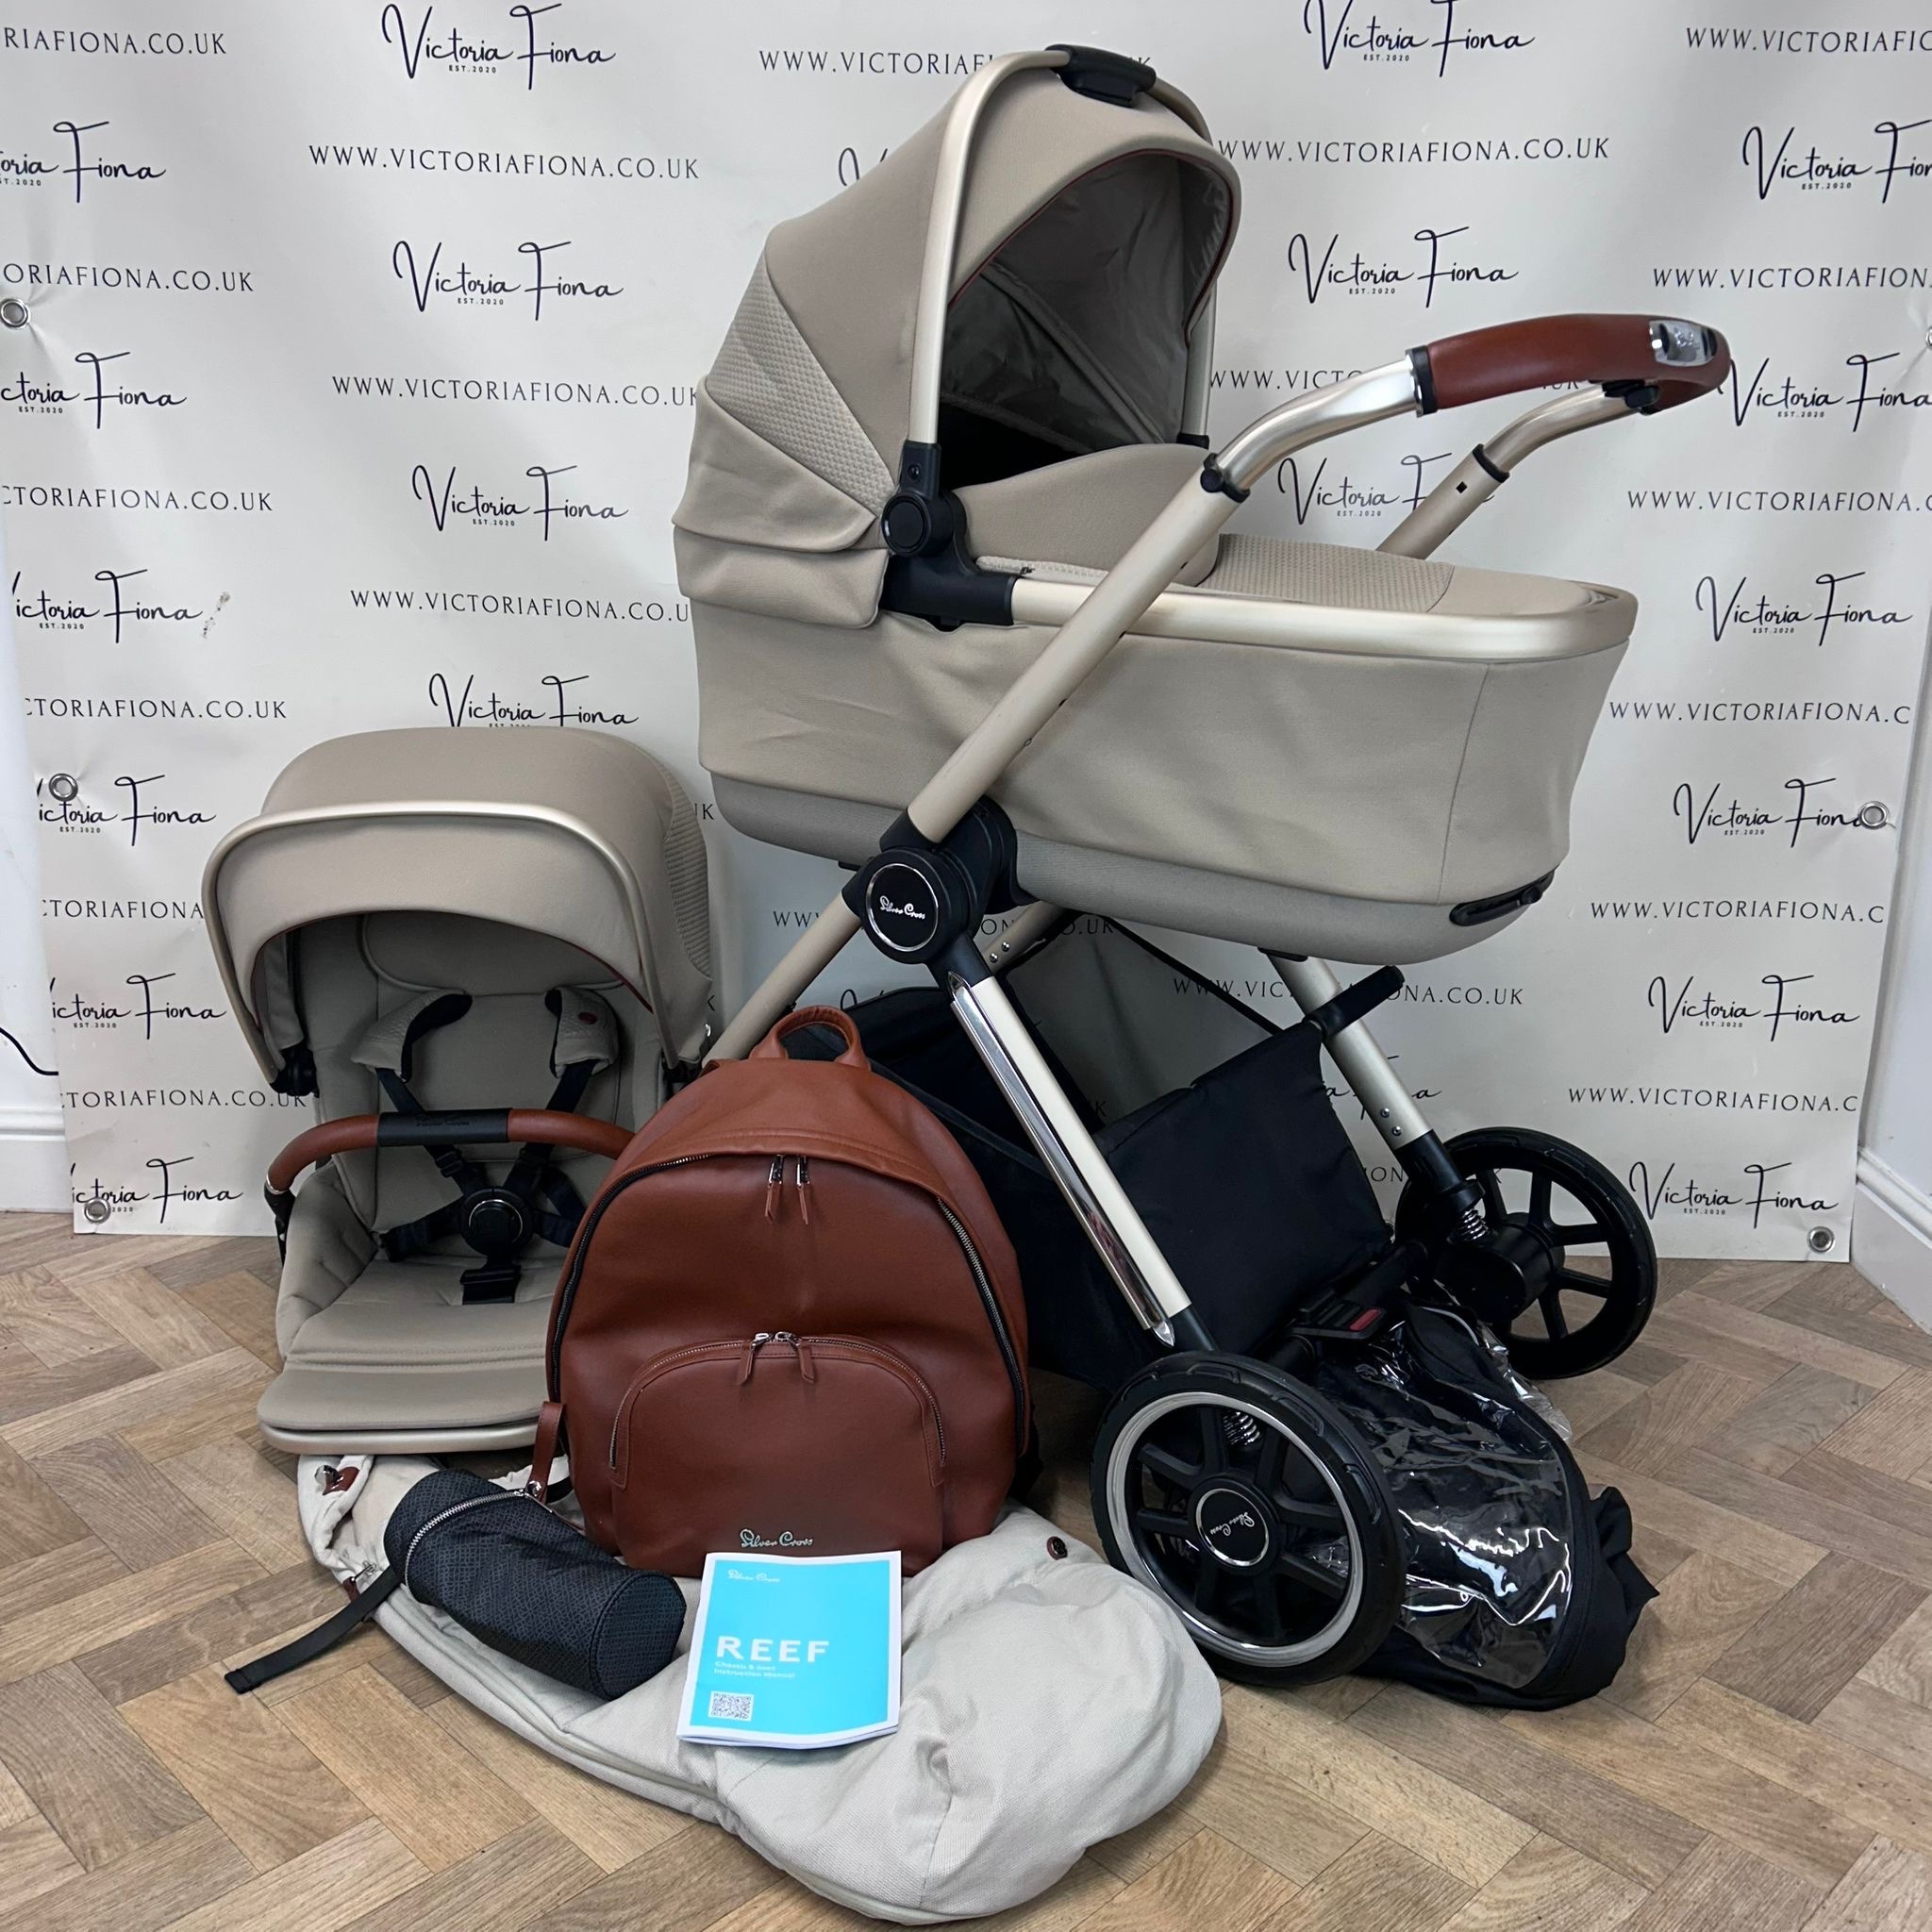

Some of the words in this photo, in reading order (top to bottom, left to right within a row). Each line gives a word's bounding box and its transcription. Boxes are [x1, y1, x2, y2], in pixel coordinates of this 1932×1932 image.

[381, 3, 514, 79] Victoria
[509, 3, 616, 91] Fiona
[449, 64, 496, 74] EST.2020
[1304, 0, 1429, 70] Victoria
[1431, 0, 1535, 77] Fiona
[0, 151, 58, 175] oria
[53, 121, 166, 204] Fiona
[309, 145, 699, 178] WWW.VICTORIAFIONA.CO.UK
[1219, 138, 1609, 162] WWW.VICTORIAFIONA.CO.UK
[1742, 126, 1873, 200] Victoria
[3, 263, 254, 291] ORIAFIONA.CO.UK
[392, 241, 521, 312] Victoria
[517, 242, 624, 321] Fiona
[1288, 234, 1415, 304] Victoria
[1414, 226, 1519, 308] Fiona
[1654, 267, 1932, 289] WWW.VICTORIAFION
[458, 297, 504, 306] EST.2020
[18, 406, 63, 414] EST.2020
[74, 352, 187, 429] Fiona
[412, 465, 531, 532] Victoria
[525, 465, 628, 541] Fiona
[473, 518, 515, 526] EST.2020
[1276, 455, 1400, 525] Victoria
[92, 569, 203, 643] Fiona
[1695, 576, 1813, 641] Victoria
[1814, 572, 1913, 646] Fiona
[428, 673, 546, 727] Victoria
[541, 675, 639, 727] Fiona
[1609, 702, 1910, 724] WWW.VICTORIAFIONA.C
[37, 778, 117, 824] ictoria
[111, 774, 216, 846] Fiona
[1674, 783, 1783, 844] Victoria
[42, 899, 203, 919] TORIAFIONA
[1591, 901, 1884, 923] WWW.VICTORIAFIONA.C
[50, 977, 131, 1021] ictoria
[126, 973, 226, 1040] Fiona
[1648, 975, 1761, 1034] Victoria
[1761, 974, 1860, 1041] Fiona
[1569, 1088, 1857, 1111] WWW.VICTORIAFIONA.C
[143, 1157, 243, 1224] Fiona
[1628, 1161, 1743, 1220] Victoria
[1743, 1162, 1839, 1229] Fiona
[740, 1528, 777, 1547] Silver
[779, 1531, 813, 1547] Cross
[717, 1636, 829, 1663] REEF
